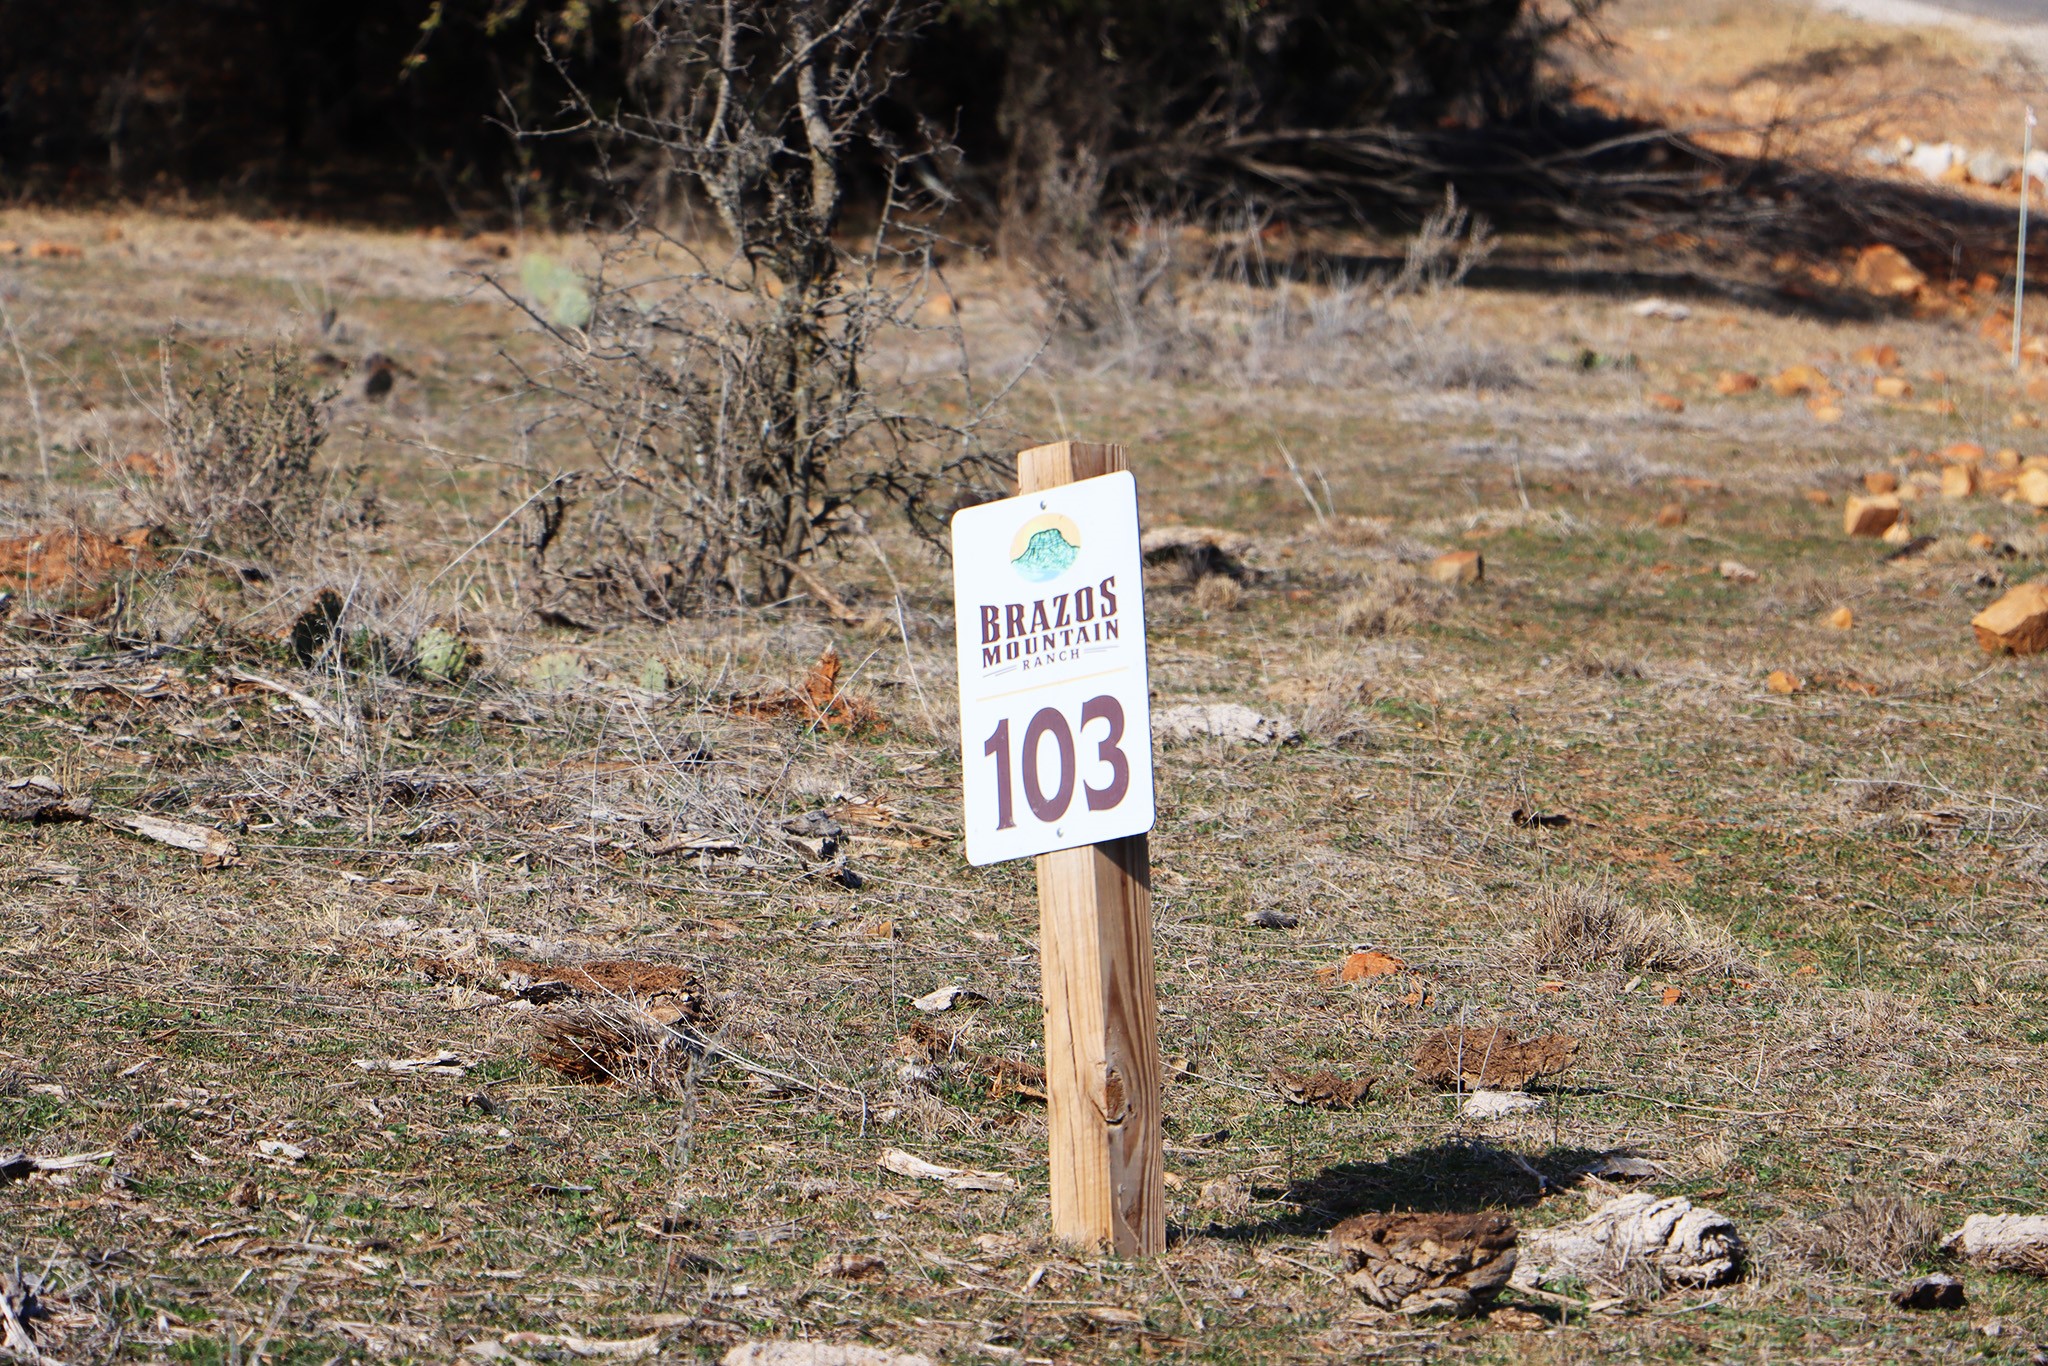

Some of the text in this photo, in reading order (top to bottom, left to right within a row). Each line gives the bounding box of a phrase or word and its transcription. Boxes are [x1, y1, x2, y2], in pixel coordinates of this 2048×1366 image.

[980, 575, 1118, 644] BRAZOS
[982, 619, 1119, 668] MOUNTAIN
[1023, 649, 1080, 670] RANCH
[984, 694, 1130, 830] 103
